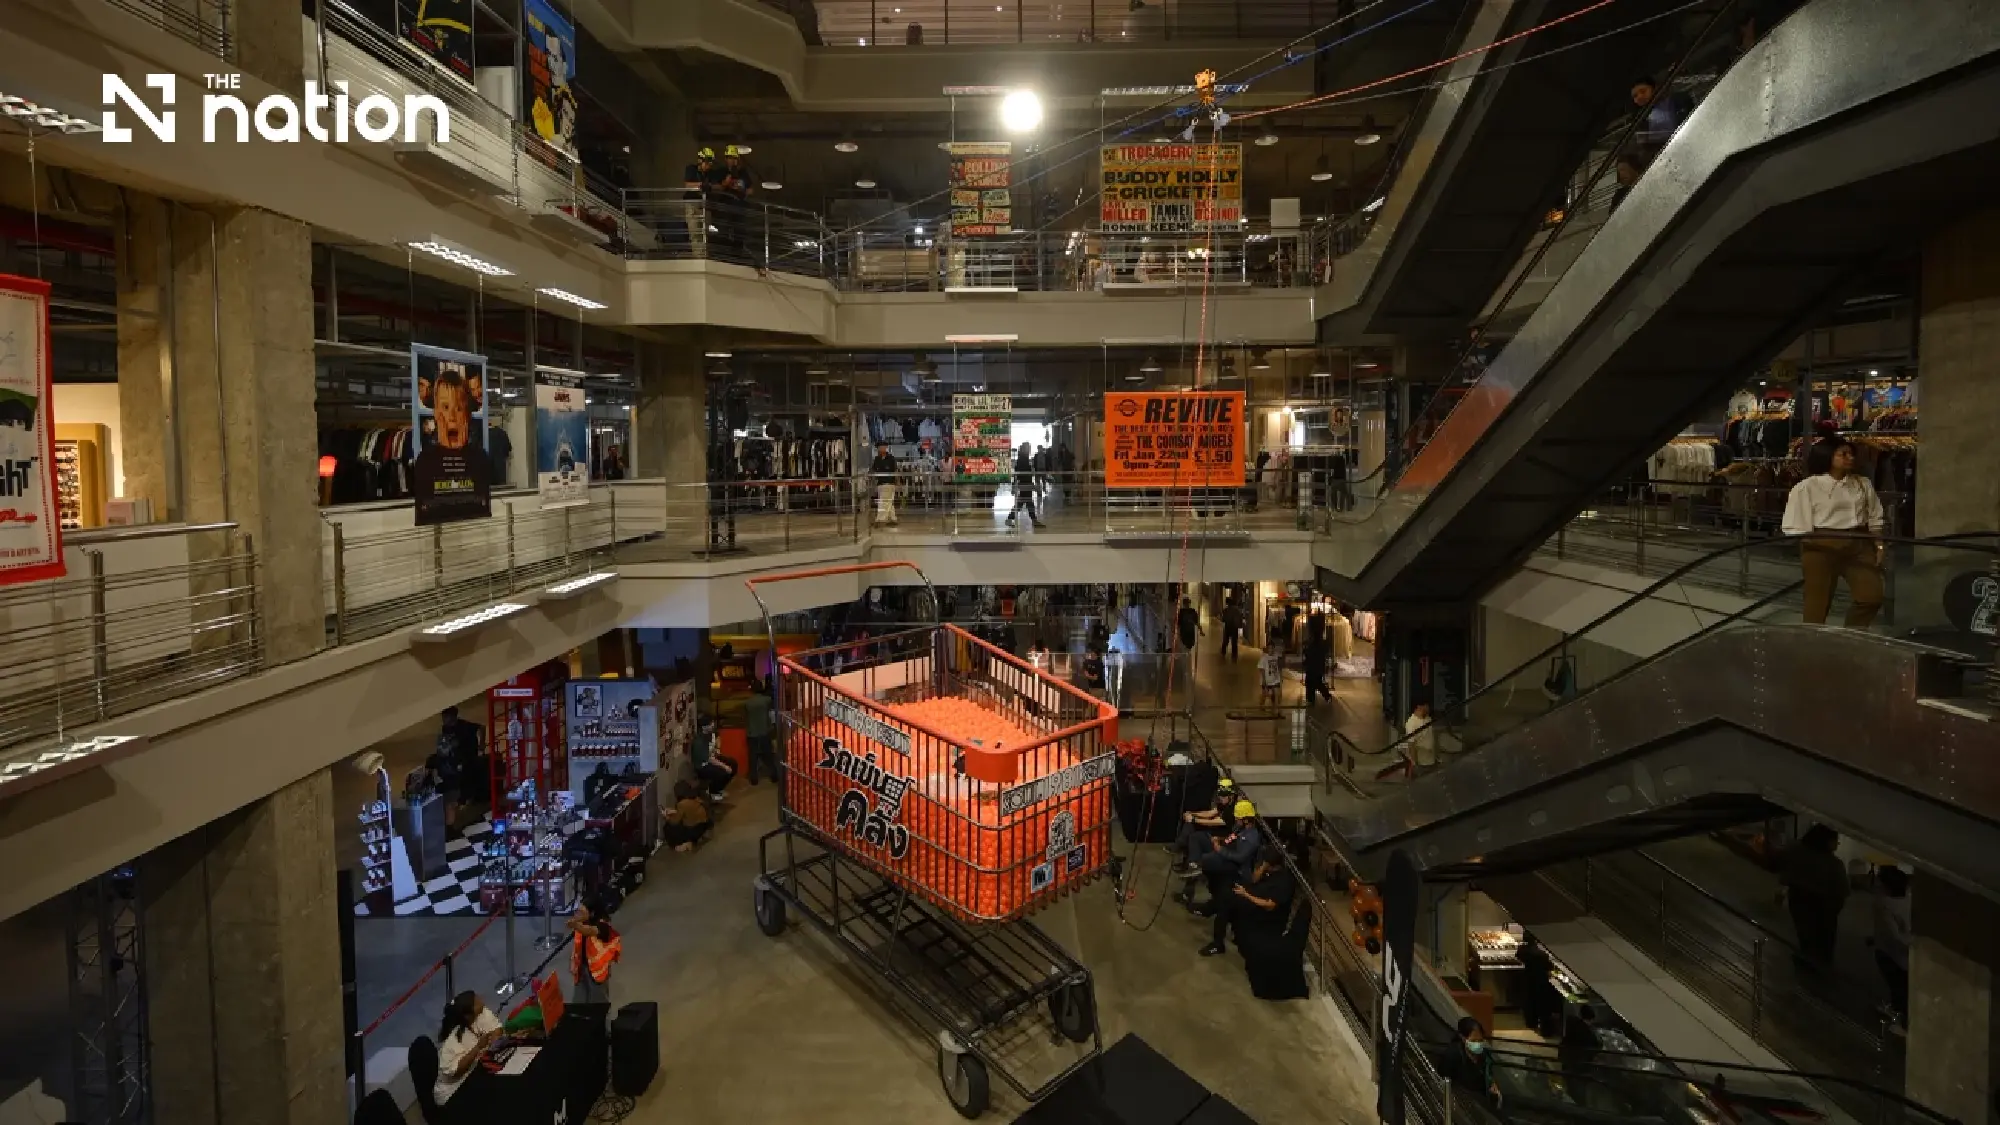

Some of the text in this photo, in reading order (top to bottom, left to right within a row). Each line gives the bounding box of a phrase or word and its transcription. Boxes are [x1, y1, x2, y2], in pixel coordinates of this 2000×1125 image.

[1104, 170, 1236, 183] BUDDY HOLLY
[1120, 186, 1217, 199] CRICKETS
[1103, 209, 1147, 221] MILLER
[1145, 398, 1234, 423] REVIVE
[1137, 436, 1153, 448] THE
[1198, 435, 1233, 448] ANGELS
[1114, 450, 1129, 459] Fri
[1132, 451, 1155, 459] Jan
